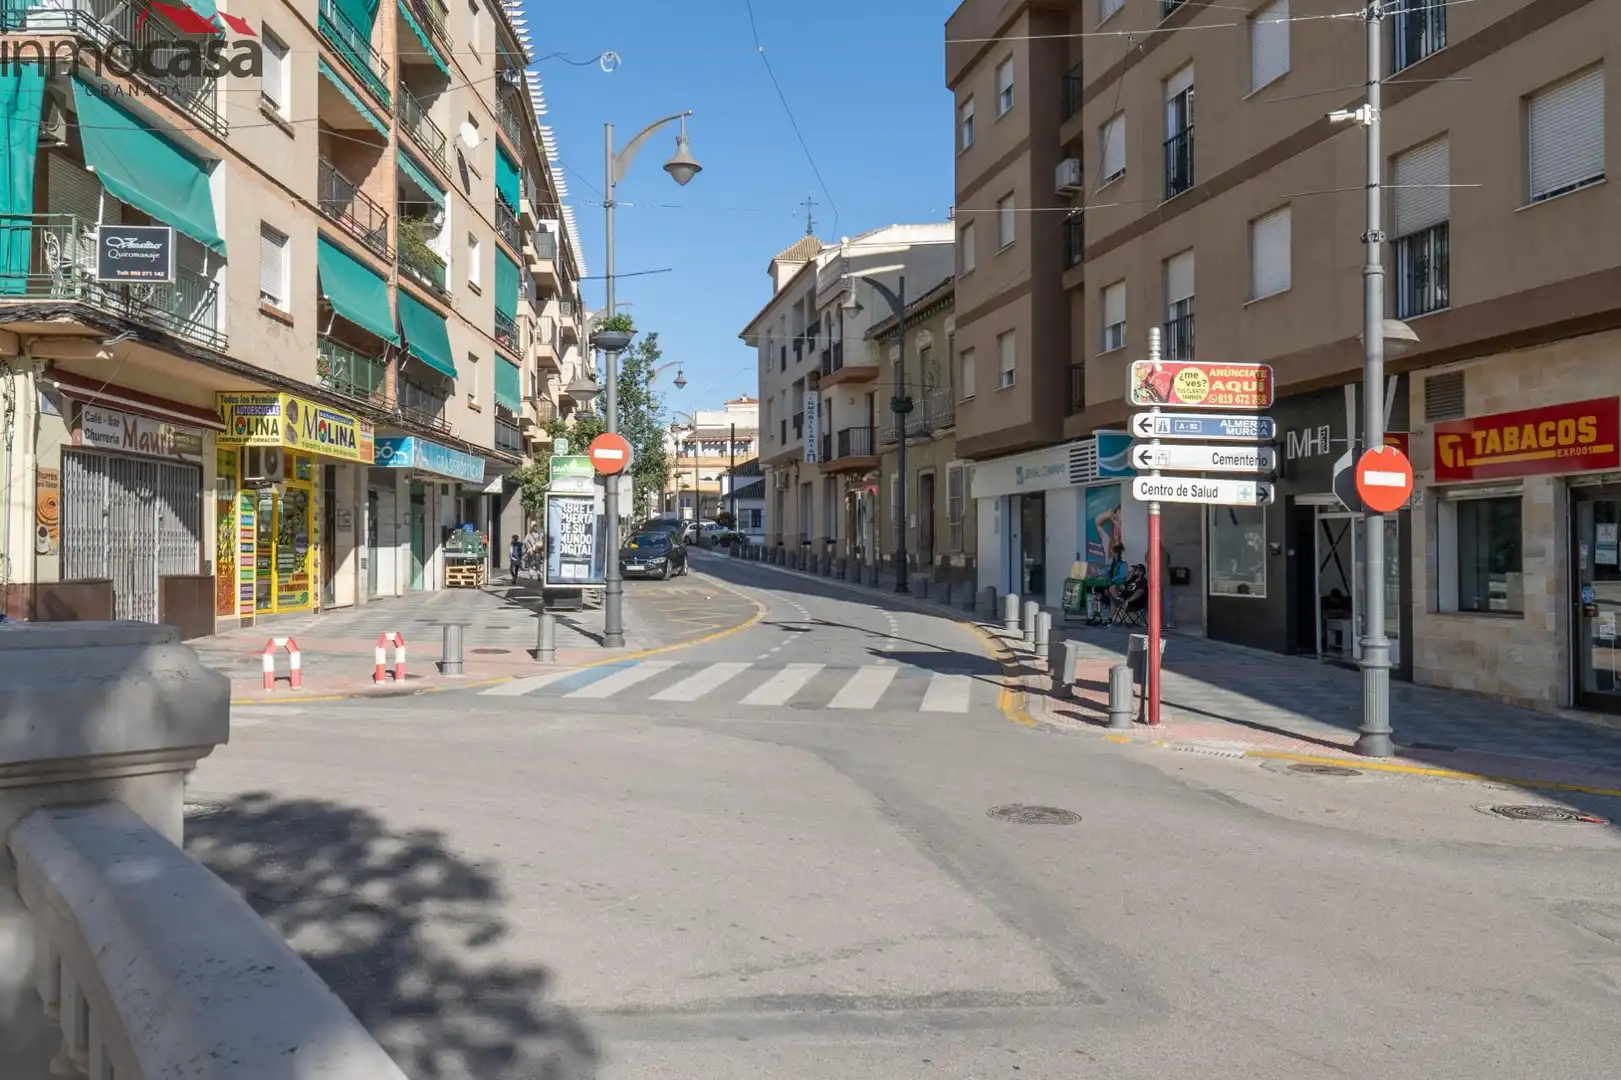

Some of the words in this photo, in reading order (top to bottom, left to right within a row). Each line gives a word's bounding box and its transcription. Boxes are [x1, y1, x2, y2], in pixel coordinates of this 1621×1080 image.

[108, 249, 160, 262] Quiromasaje
[1179, 371, 1199, 381] ¿me
[1209, 366, 1267, 377] ANÚNCIATE
[1186, 379, 1207, 387] ves?
[1211, 379, 1265, 392] AQUÍ
[220, 394, 238, 403] Todos
[236, 406, 279, 414] AUTOESCUELAS
[84, 411, 102, 424] Café
[218, 404, 279, 436] MOLINA
[302, 405, 356, 449] MOLINA
[84, 428, 120, 445] Churrería
[1471, 415, 1597, 455] TABACOS
[1211, 452, 1268, 467] Cementerio
[1140, 482, 1173, 496] Centro
[1176, 483, 1188, 496] de
[1190, 484, 1219, 498] Salud
[560, 513, 593, 524] PUERTA
[560, 523, 571, 533] DE
[572, 523, 586, 534] SU
[560, 533, 592, 544] MUNDO
[560, 543, 592, 555] DIGITAL
